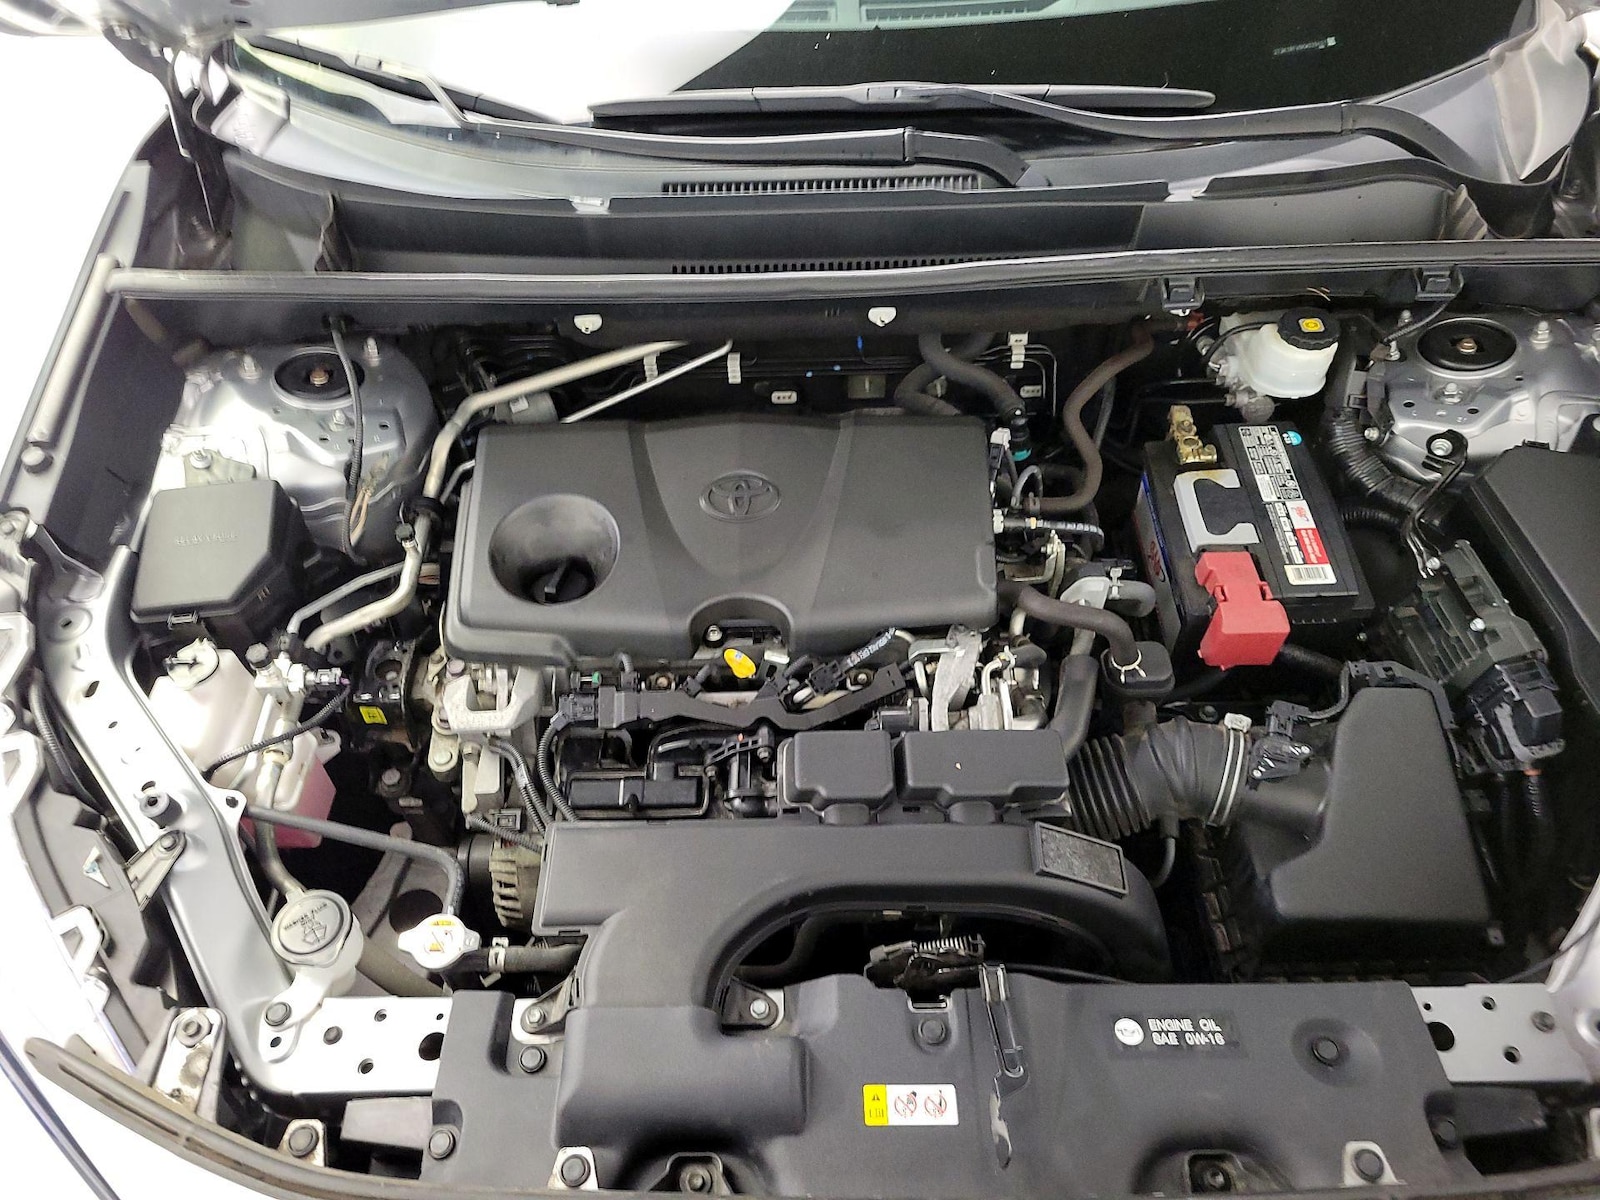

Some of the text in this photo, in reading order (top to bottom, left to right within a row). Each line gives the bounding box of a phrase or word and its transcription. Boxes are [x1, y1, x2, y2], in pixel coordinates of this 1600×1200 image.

[1147, 1018, 1222, 1032] ENGINE OIL
[1151, 1032, 1225, 1045] SAE 0W-16
